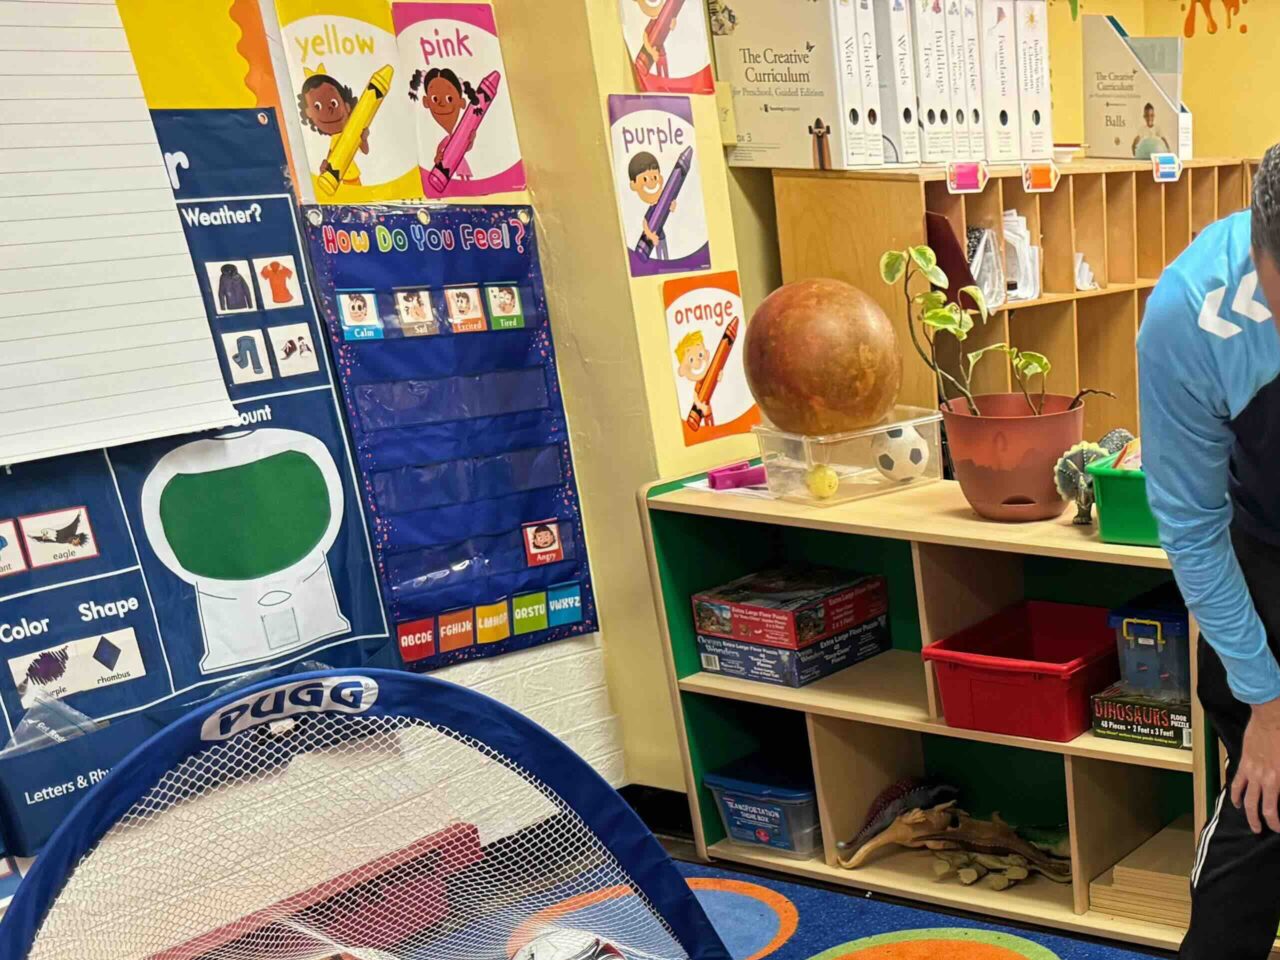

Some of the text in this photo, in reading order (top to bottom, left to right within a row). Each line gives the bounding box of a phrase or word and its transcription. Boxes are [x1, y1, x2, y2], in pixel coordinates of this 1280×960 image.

[295, 23, 375, 63] yellow
[419, 28, 473, 65] pink
[739, 48, 810, 64] The Creative
[844, 36, 855, 77] Water
[862, 32, 874, 87] Clothes
[897, 35, 909, 86] Wheels
[935, 30, 946, 94] Buildings
[998, 35, 1008, 97] Foundation
[745, 67, 810, 83] Curriculum
[1105, 115, 1126, 127] Balls
[622, 118, 684, 153] purple
[181, 203, 262, 227] Weather?
[322, 218, 525, 254] How Do You Feel?
[500, 317, 517, 328] Tired
[674, 300, 733, 327] orange
[353, 327, 375, 338] Calm
[53, 549, 76, 560] eagle
[536, 552, 557, 563] Angry
[79, 596, 139, 622] Shape
[0, 618, 50, 643] Color
[401, 630, 433, 647] ABCDE
[97, 671, 131, 685] rhombus
[219, 680, 365, 736] PUGG
[1095, 699, 1169, 728] DINOSAURS
[1170, 713, 1187, 722] FLOOR
[1101, 720, 1109, 728] 48
[1109, 721, 1127, 730] Pieces
[1137, 726, 1150, 734] Feet
[24, 782, 75, 805] Letters
[76, 775, 89, 789] &
